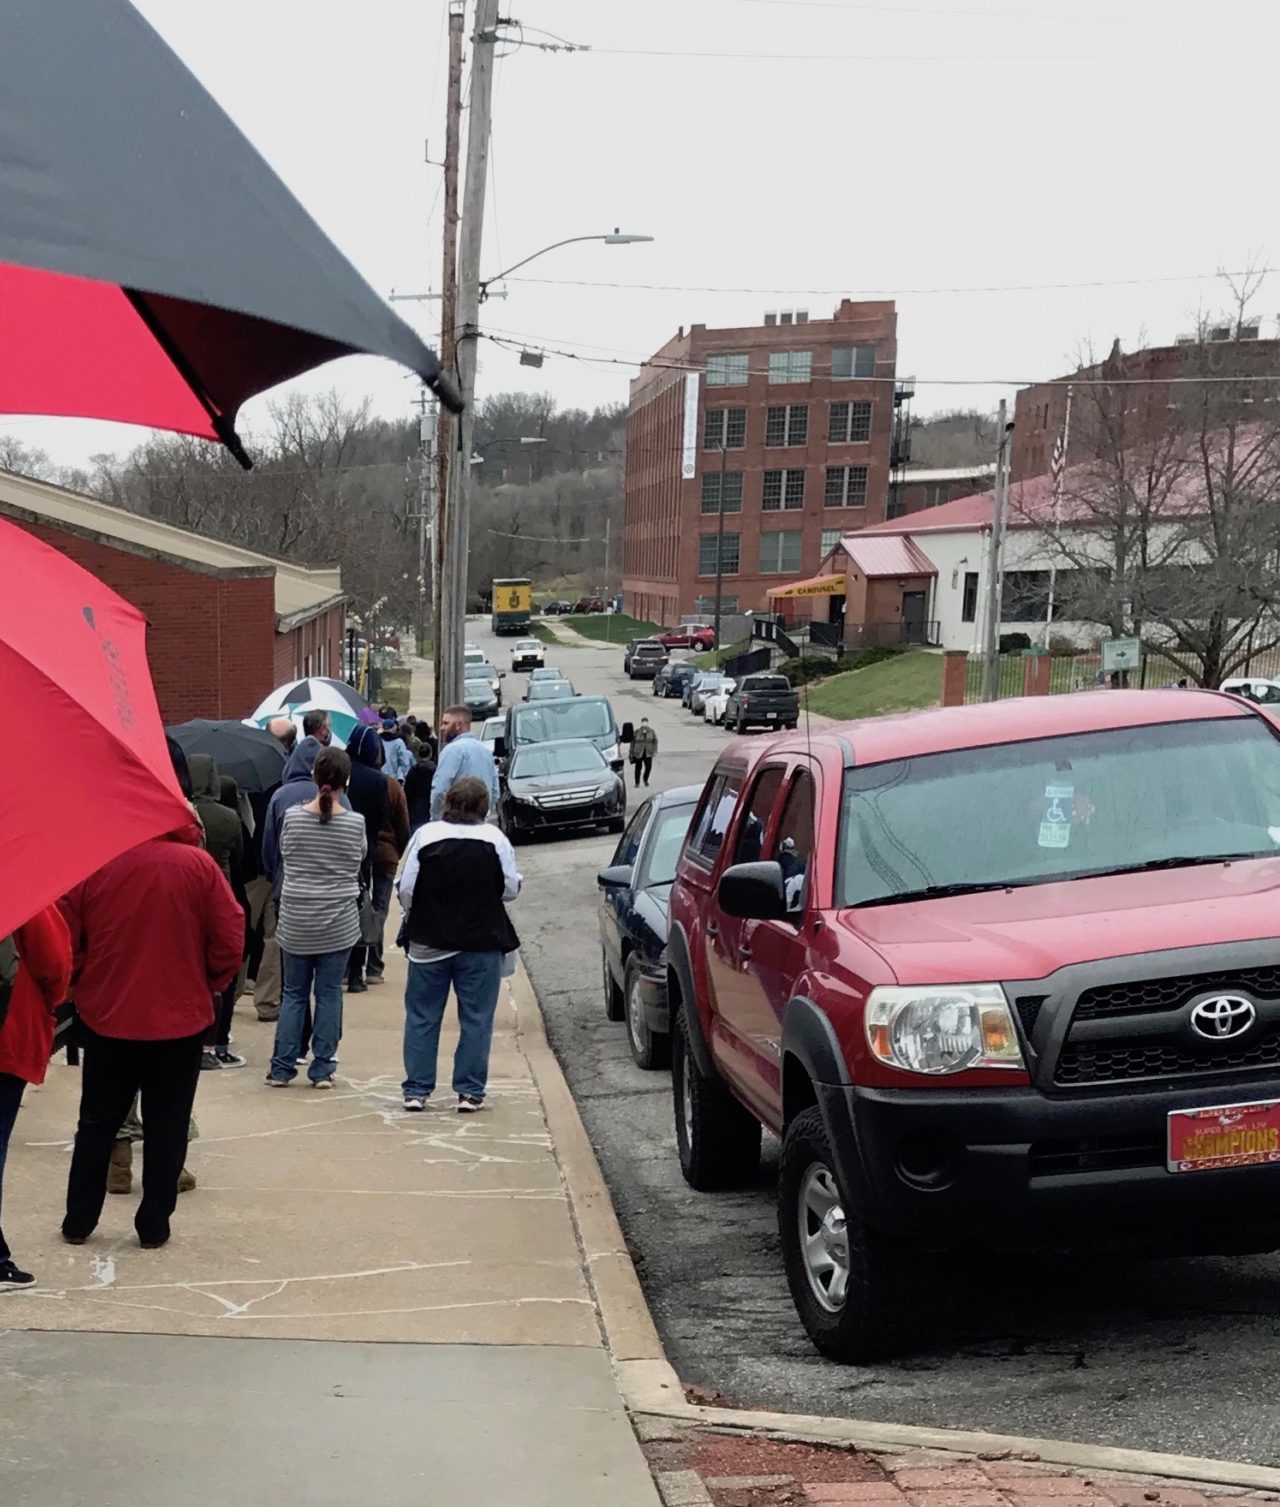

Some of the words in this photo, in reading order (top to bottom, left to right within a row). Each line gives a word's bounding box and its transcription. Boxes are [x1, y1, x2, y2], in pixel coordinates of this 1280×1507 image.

[797, 585, 836, 594] CAROUSEL
[1195, 1126, 1221, 1136] SUPER
[1224, 1123, 1247, 1133] BOWL
[1252, 1122, 1267, 1130] LIV
[1183, 1127, 1279, 1160] CHAMPIONS
[1197, 1153, 1265, 1170] CHAMPIONS
